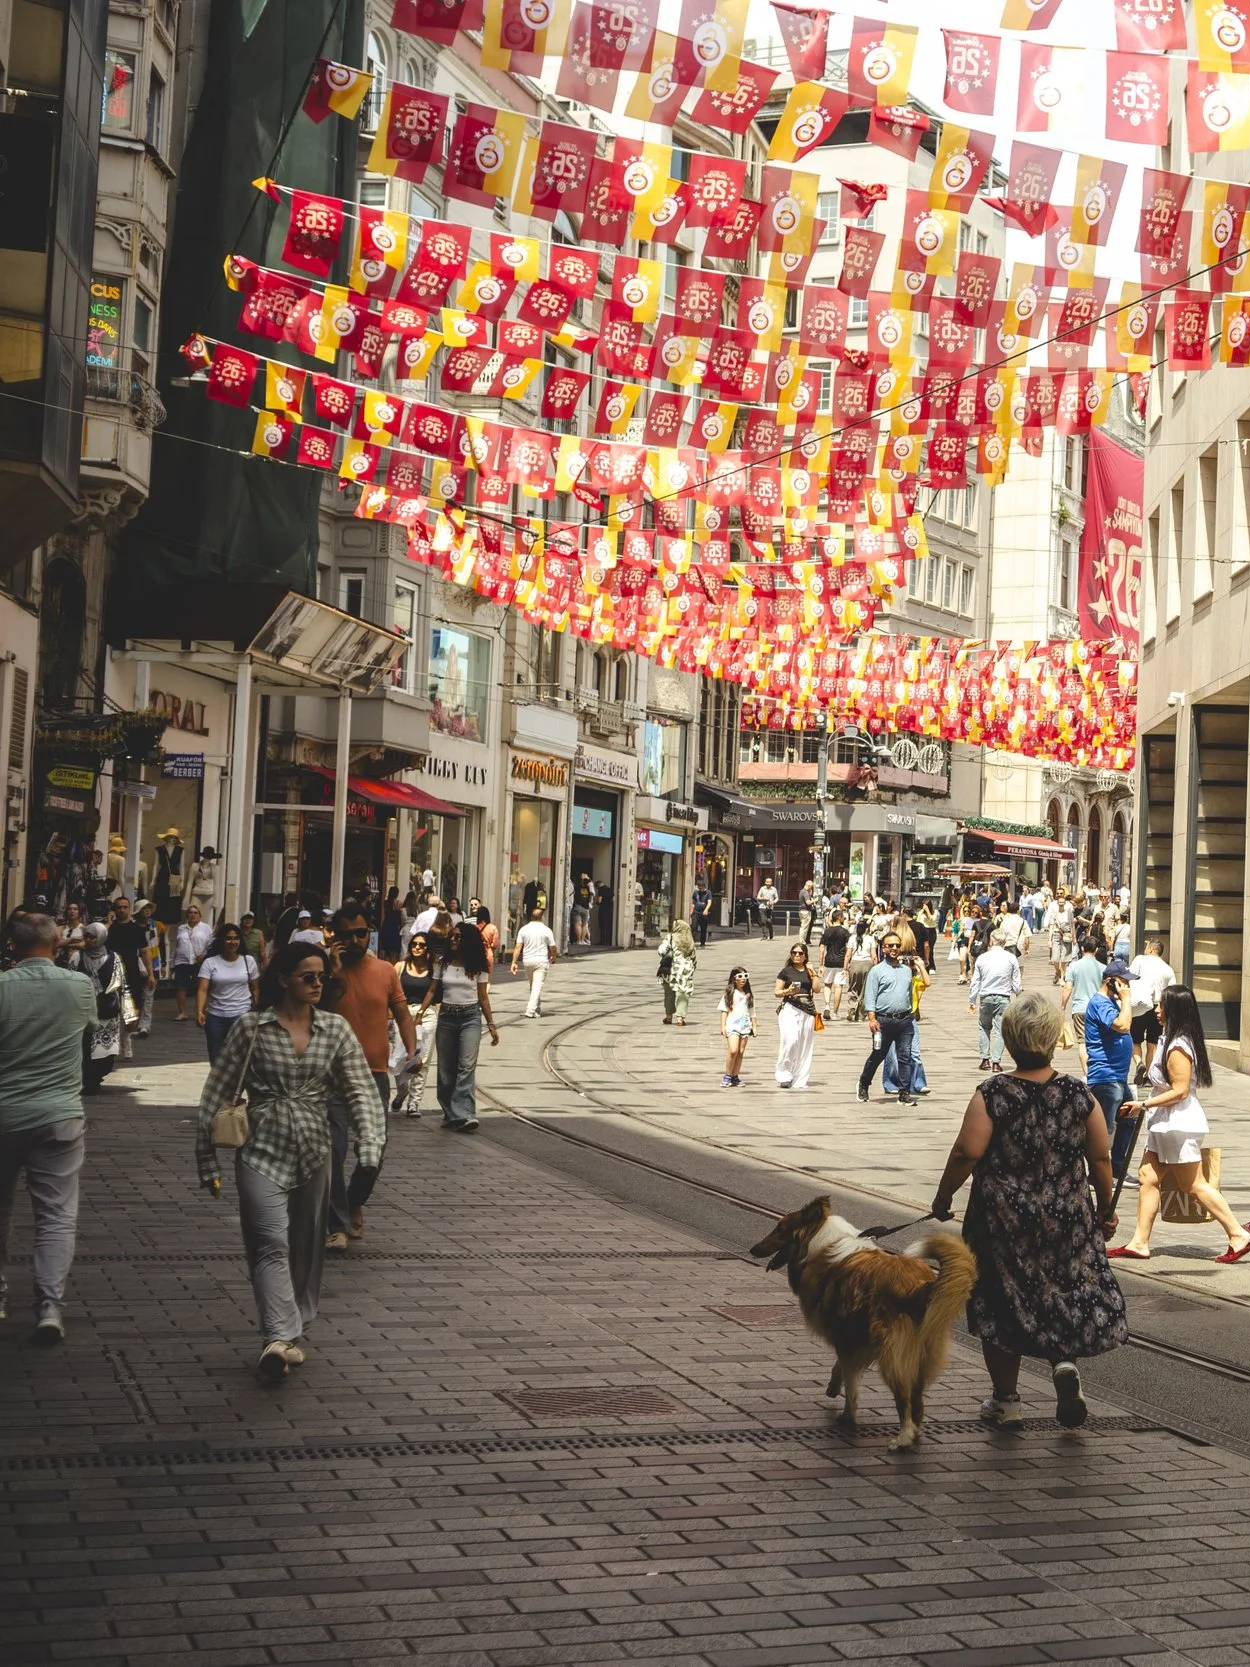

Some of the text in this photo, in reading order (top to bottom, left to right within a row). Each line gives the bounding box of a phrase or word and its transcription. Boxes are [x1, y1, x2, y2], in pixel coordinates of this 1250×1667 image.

[1021, 173, 1041, 199] 26
[1151, 197, 1170, 225] 26
[845, 243, 866, 268] 26
[967, 276, 984, 299] 26
[537, 291, 561, 308] 26
[1073, 297, 1091, 317] 26
[395, 312, 416, 325] 26
[1183, 311, 1200, 334] 26
[511, 327, 531, 340] 26
[222, 364, 241, 380] 26
[326, 391, 345, 408] 26
[845, 387, 863, 405] 26
[957, 396, 976, 414] 26
[423, 420, 442, 435] 26
[519, 450, 537, 465] 26
[174, 768, 202, 777] BERBER
[420, 757, 488, 785] JIMMY KEY
[772, 812, 818, 822] SWAROVS
[1007, 846, 1037, 856] PERAMONA
